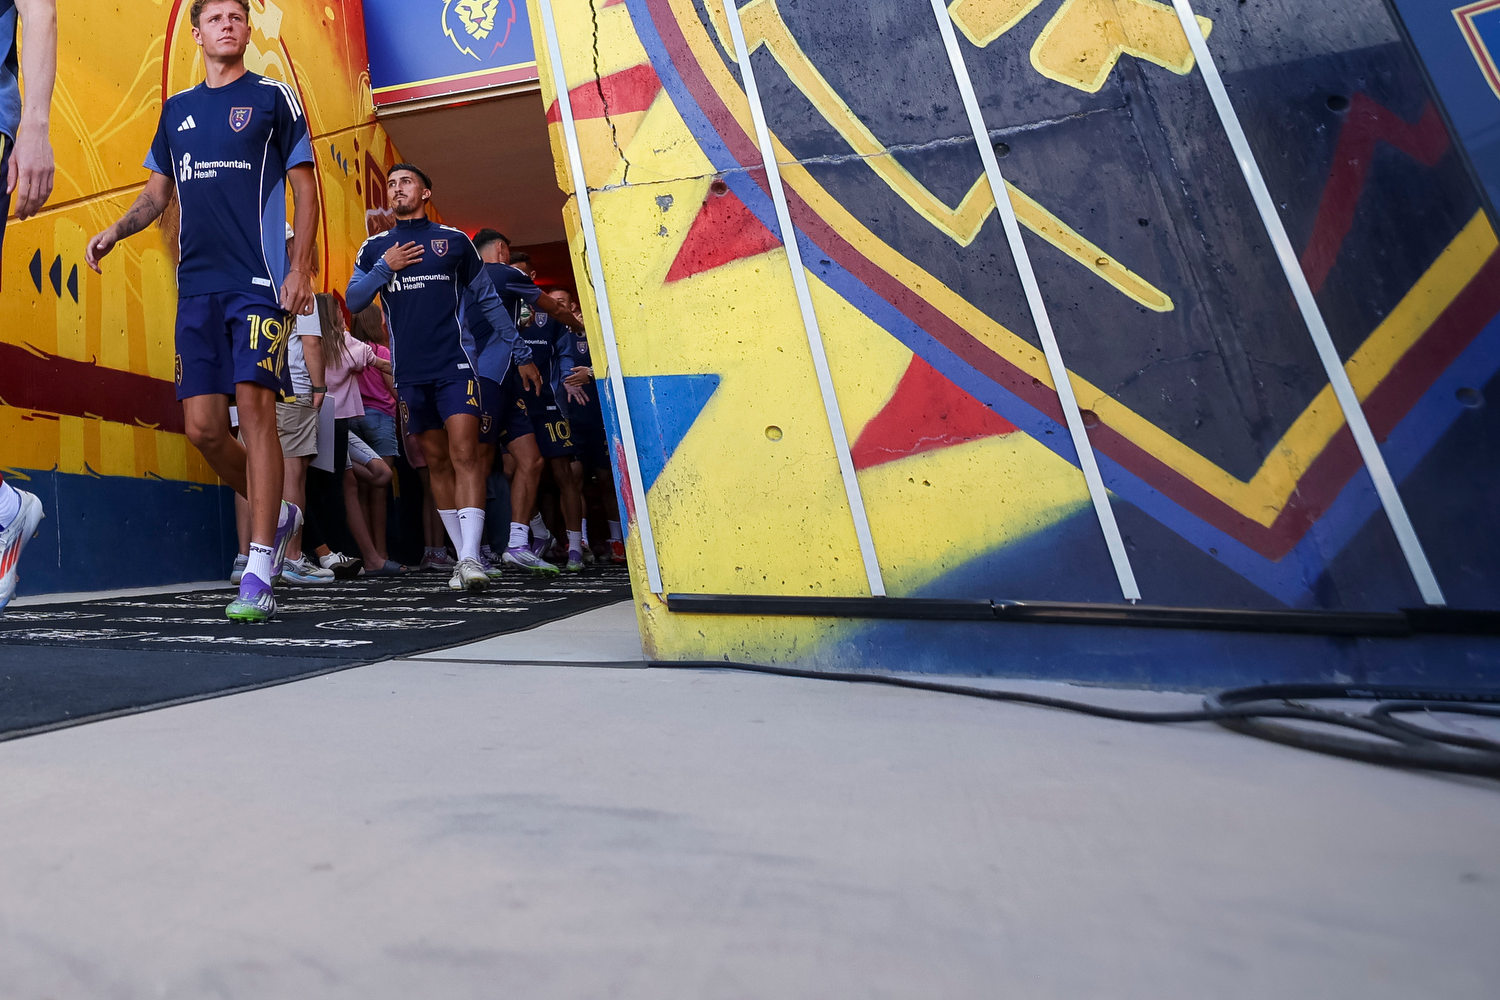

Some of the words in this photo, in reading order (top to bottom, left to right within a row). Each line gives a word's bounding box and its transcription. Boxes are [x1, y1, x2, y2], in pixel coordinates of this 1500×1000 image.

[194, 160, 252, 170] Intermountain
[193, 169, 217, 179] Health
[401, 273, 450, 283] Intermountain
[402, 281, 426, 291] Health
[246, 314, 283, 354] 19
[544, 420, 572, 442] 10
